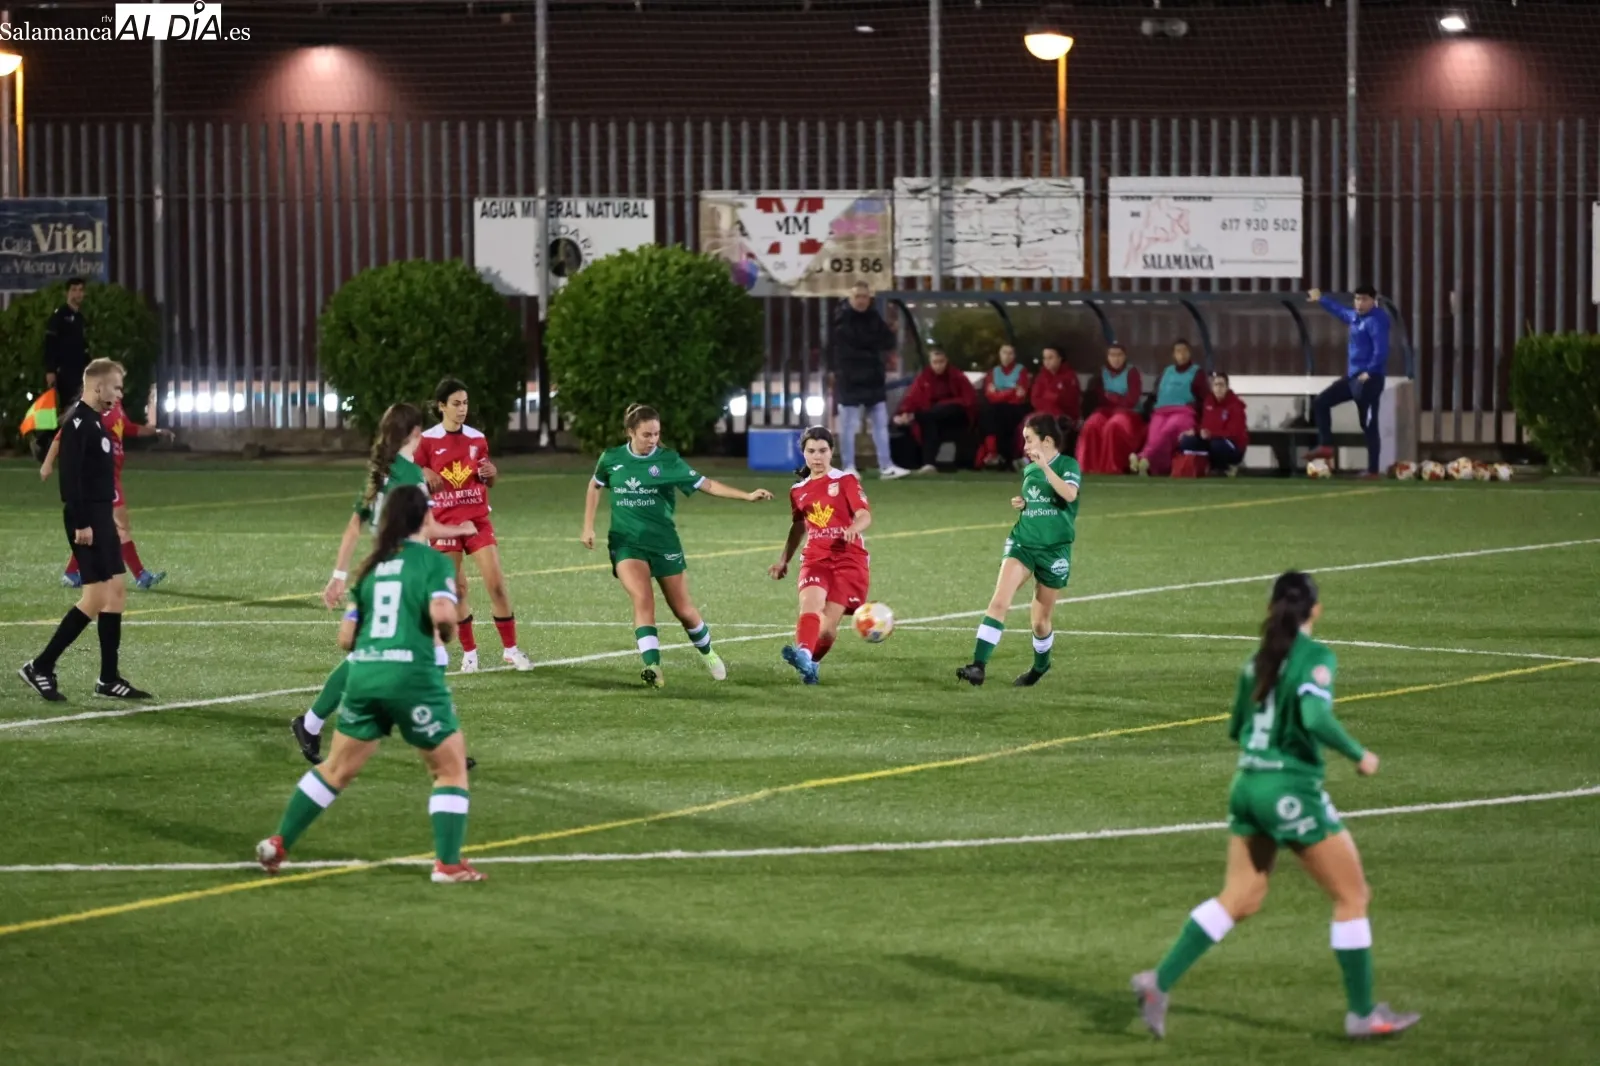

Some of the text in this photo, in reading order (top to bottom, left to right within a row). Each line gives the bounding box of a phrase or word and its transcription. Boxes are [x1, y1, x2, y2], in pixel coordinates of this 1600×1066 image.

[480, 201, 649, 219] AGUA MIERAL NATURAL
[1220, 218, 1298, 232] 617 930 502
[31, 221, 104, 253] Vital
[860, 258, 883, 273] 86
[1142, 254, 1215, 270] SALAMANCA
[370, 581, 402, 638] 8
